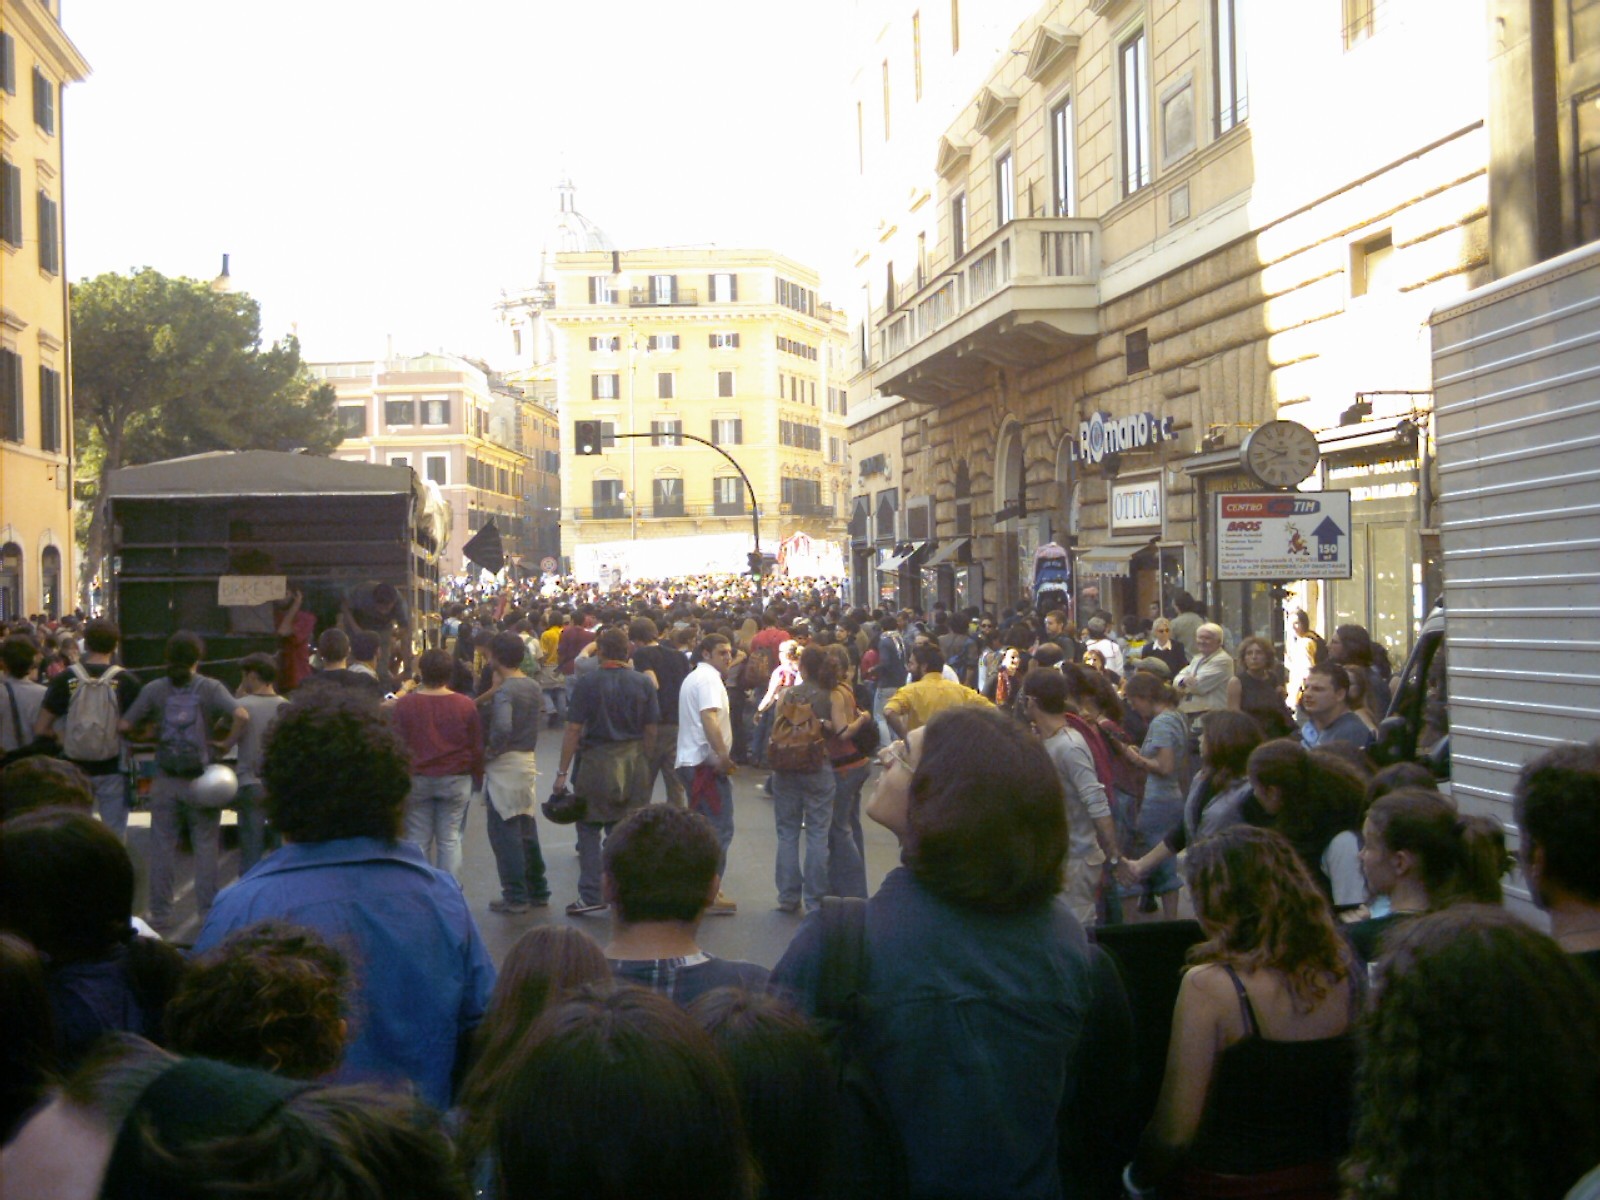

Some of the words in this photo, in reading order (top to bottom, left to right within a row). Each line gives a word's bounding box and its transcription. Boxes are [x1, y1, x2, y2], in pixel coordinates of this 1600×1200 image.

[1115, 488, 1160, 520] OTTICA
[1226, 503, 1263, 513] CENTRO
[1293, 501, 1316, 512] TIM
[1319, 543, 1338, 554] 150
